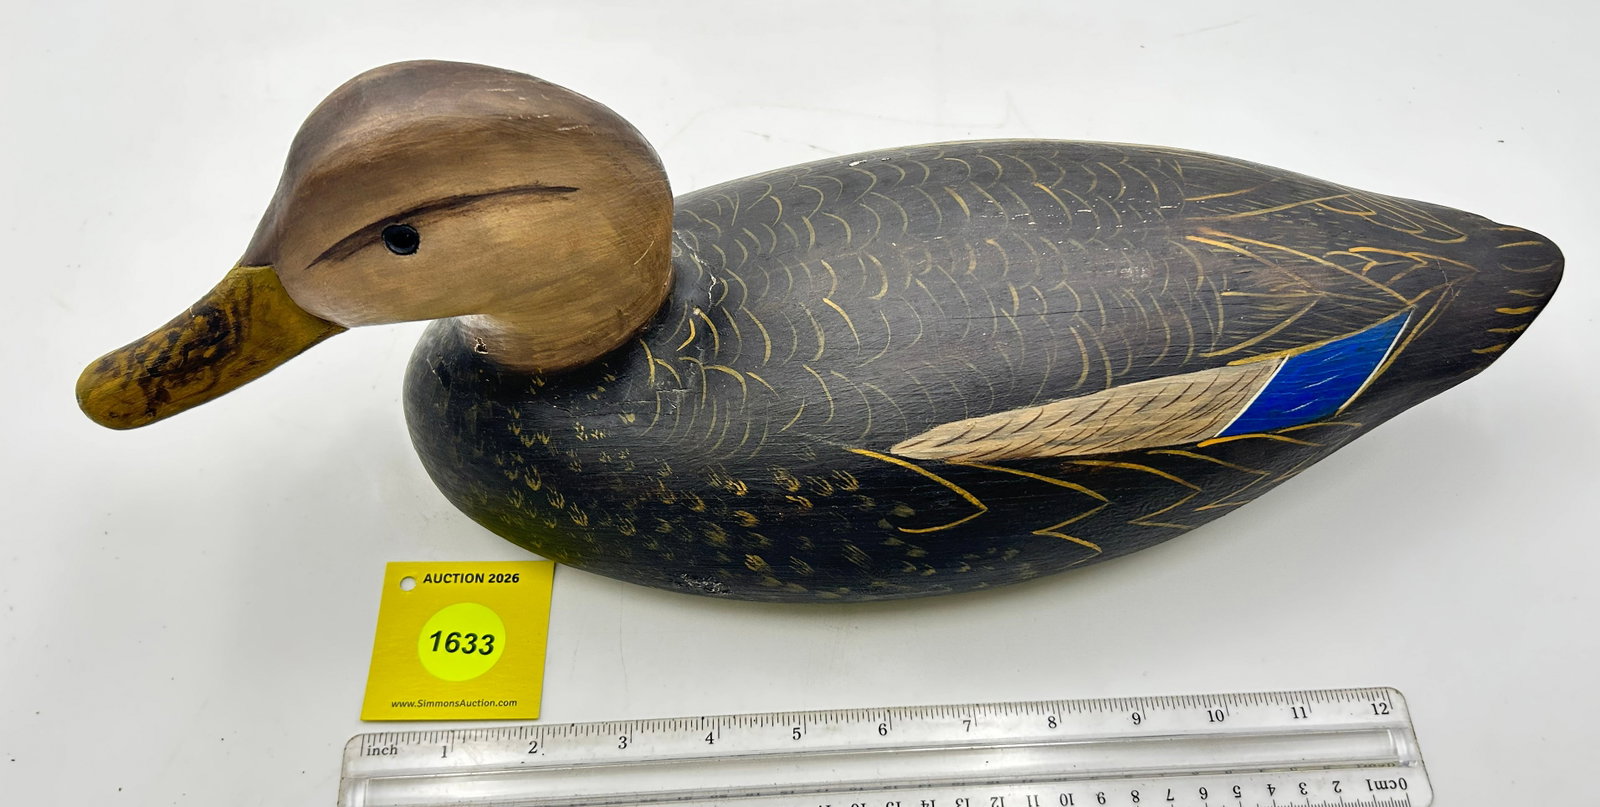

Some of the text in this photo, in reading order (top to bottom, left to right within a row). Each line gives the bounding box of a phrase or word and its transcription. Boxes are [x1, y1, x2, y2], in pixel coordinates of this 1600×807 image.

[423, 573, 520, 584] AUCTION 2026
[429, 630, 495, 656] 1633
[391, 699, 518, 708] www.SimmonsAuction.com
[367, 702, 1389, 758] inch 1 2 3 4 5 6 7 8 9 10 11 12
[1199, 787, 1208, 799] 6
[1232, 785, 1242, 798] 5
[1267, 783, 1276, 796] 4
[1299, 782, 1308, 795] 3
[1332, 780, 1342, 794] 2
[1060, 793, 1074, 806] 10
[1097, 792, 1107, 804] 9
[1131, 789, 1140, 803] 8
[1166, 788, 1175, 801] 7
